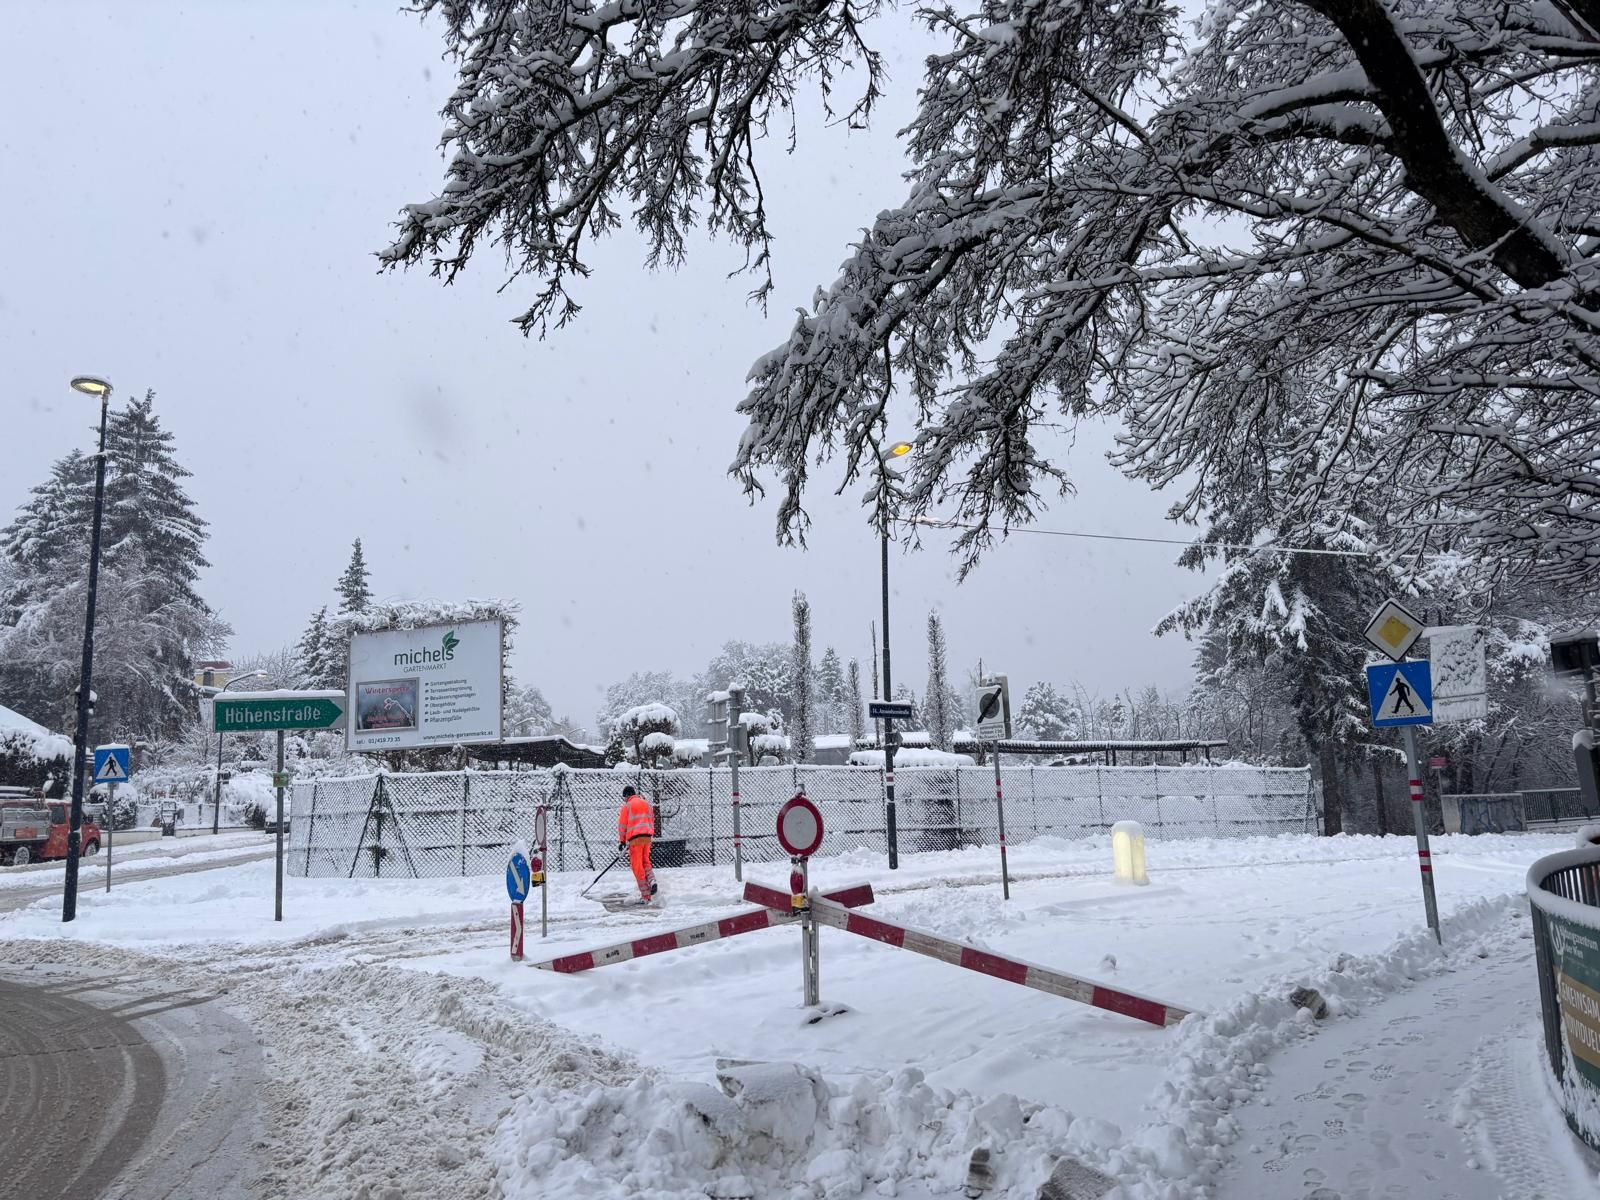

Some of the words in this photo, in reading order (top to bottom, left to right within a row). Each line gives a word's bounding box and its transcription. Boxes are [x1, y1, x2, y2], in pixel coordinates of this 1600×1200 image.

[394, 645, 455, 666] michels
[403, 663, 447, 673] GARTENMARKT
[225, 705, 321, 724] Höhenstraße
[423, 730, 494, 740] www.michels-gartenmarkt.at
